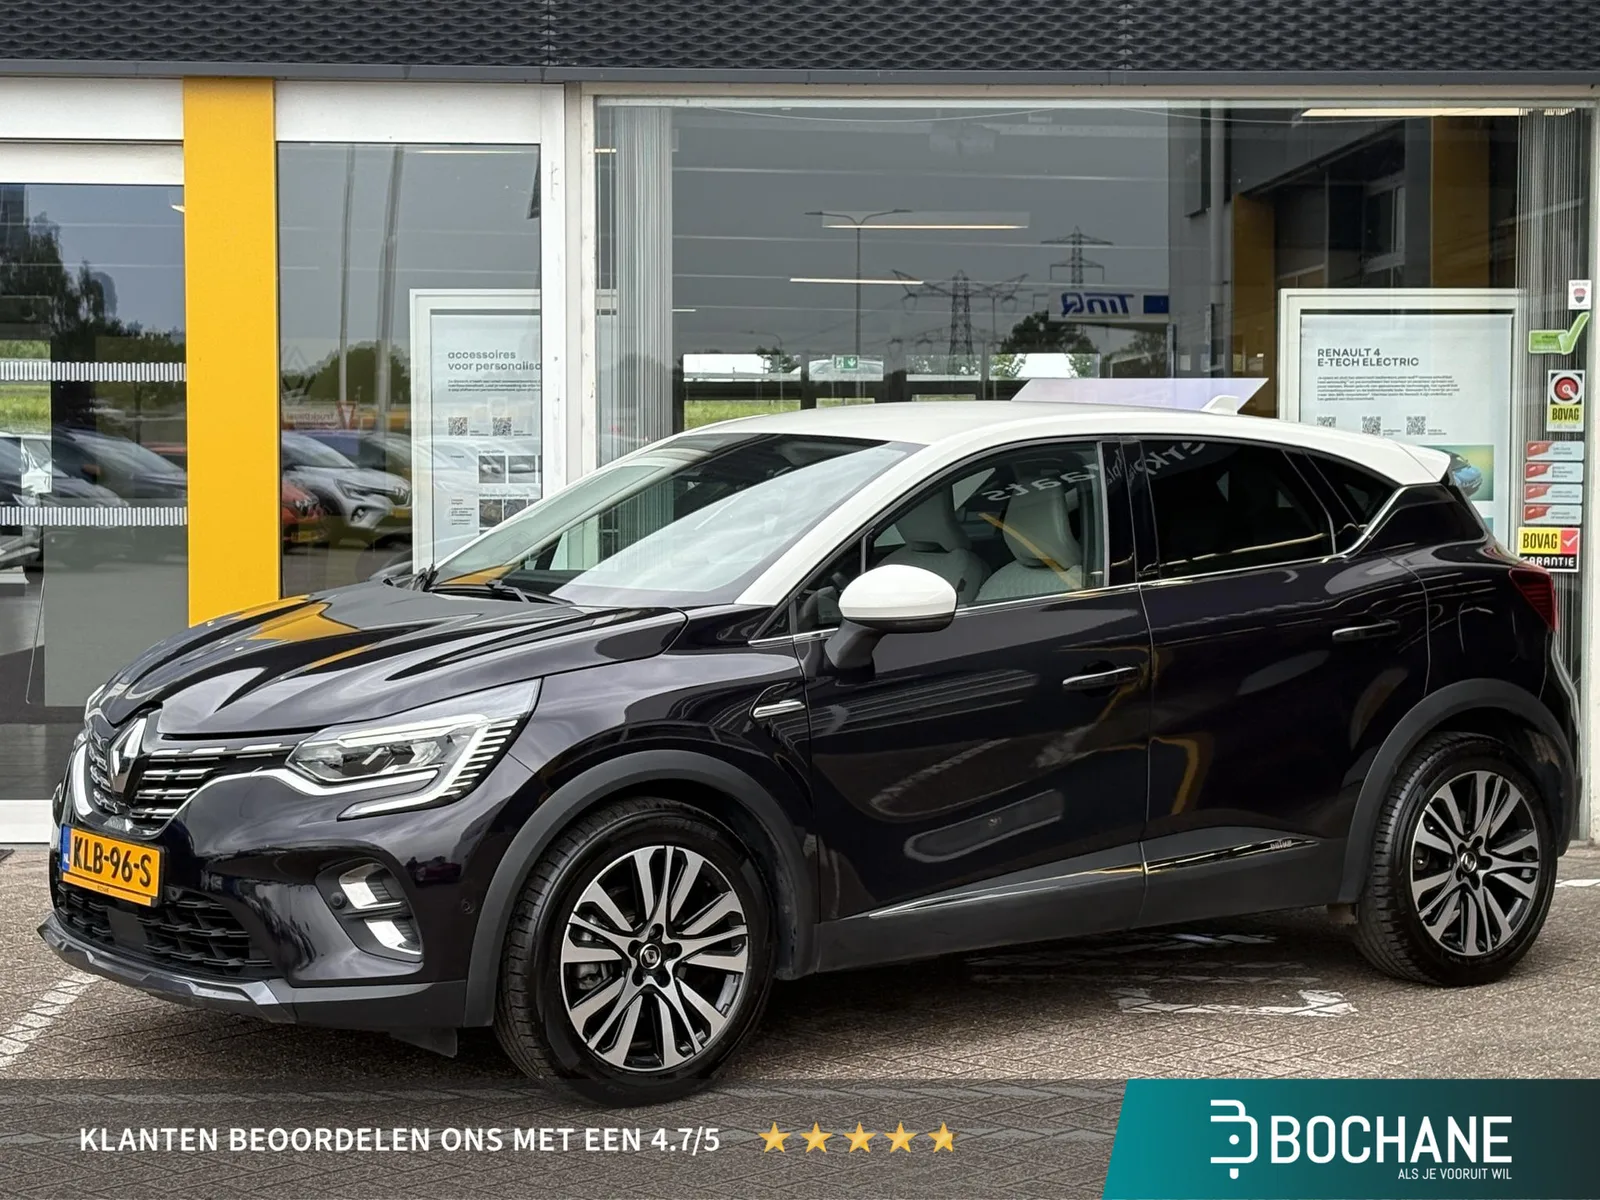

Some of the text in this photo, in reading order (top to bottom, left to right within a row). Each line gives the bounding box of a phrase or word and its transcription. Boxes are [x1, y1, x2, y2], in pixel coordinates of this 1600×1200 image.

[447, 349, 516, 360] accessoires
[1317, 348, 1381, 358] RENAULT 4
[447, 362, 474, 371] voor
[1317, 357, 1420, 367] E-TECH ELECTRIC
[1551, 407, 1580, 421] BOVAG
[1522, 533, 1558, 549] BOVAG
[73, 835, 152, 888] KLB-96-S
